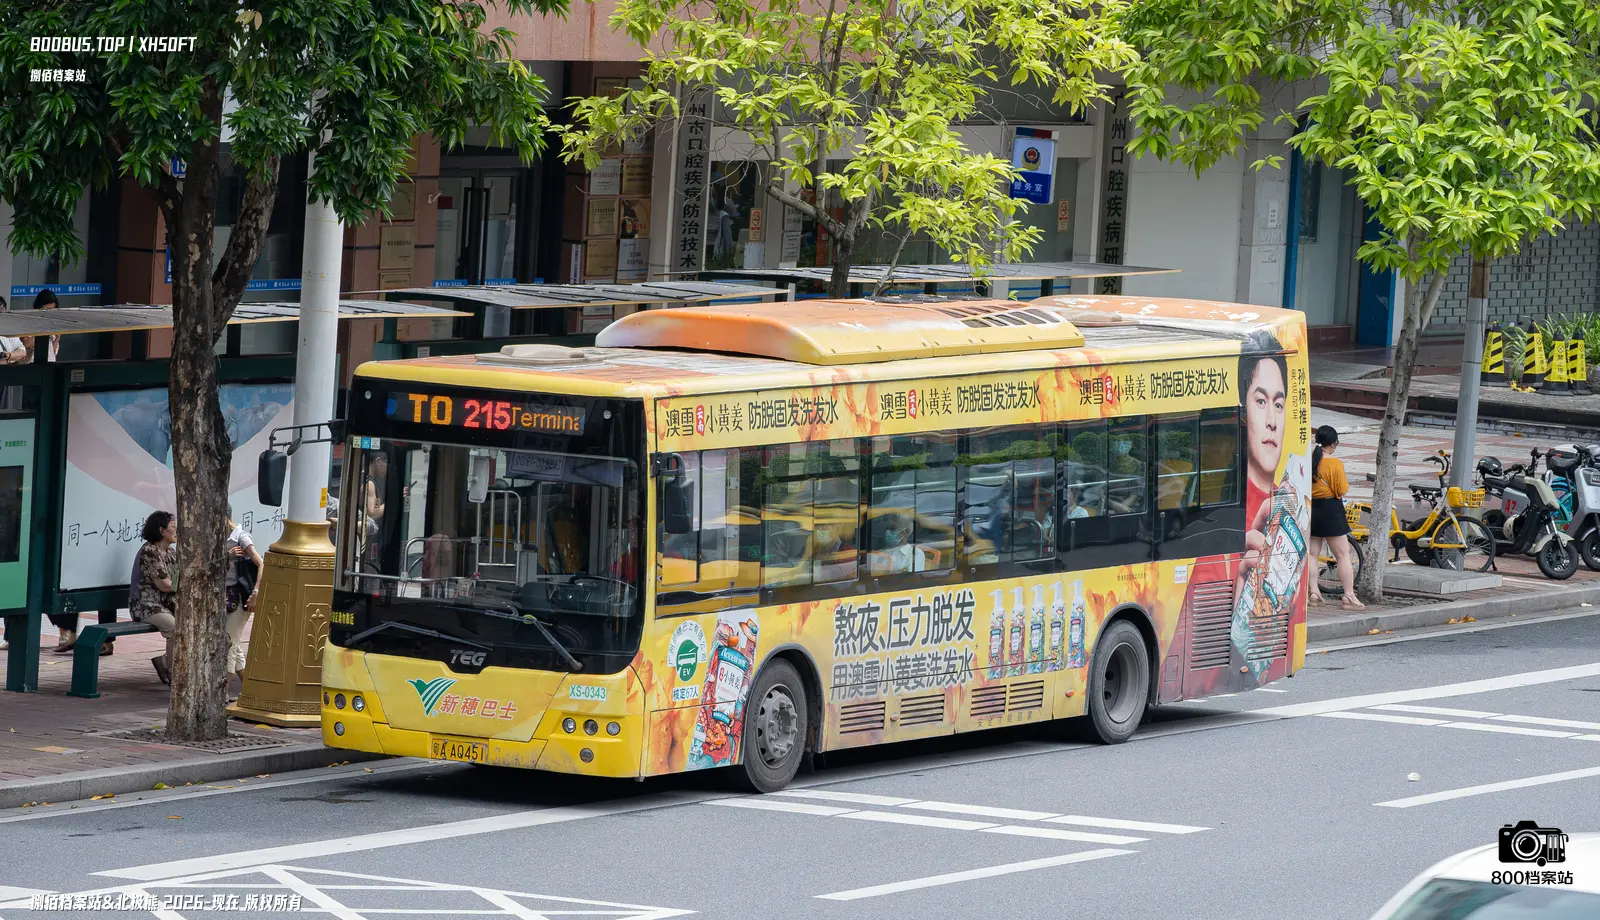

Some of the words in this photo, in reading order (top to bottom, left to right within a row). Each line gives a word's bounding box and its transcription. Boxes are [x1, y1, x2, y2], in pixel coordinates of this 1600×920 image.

[917, 387, 952, 418] 小黄姜
[956, 380, 1041, 414] 防脱固发洗发水
[1113, 374, 1146, 403] 小黄姜
[1150, 367, 1229, 399] 防脱固发洗发水
[408, 393, 452, 426] TO
[463, 399, 511, 430] 215
[705, 402, 743, 434] 小黄姜
[748, 395, 839, 431] 防脱固发洗发水
[833, 589, 975, 657] 熬夜、压力脱发
[450, 650, 487, 667] TEG
[682, 667, 691, 676] EV
[830, 646, 974, 701] 用澳雪小黄姜洗发水
[438, 693, 518, 721] 新穗巴士
[569, 685, 607, 700] XS-0343
[673, 686, 698, 700] 核定67人
